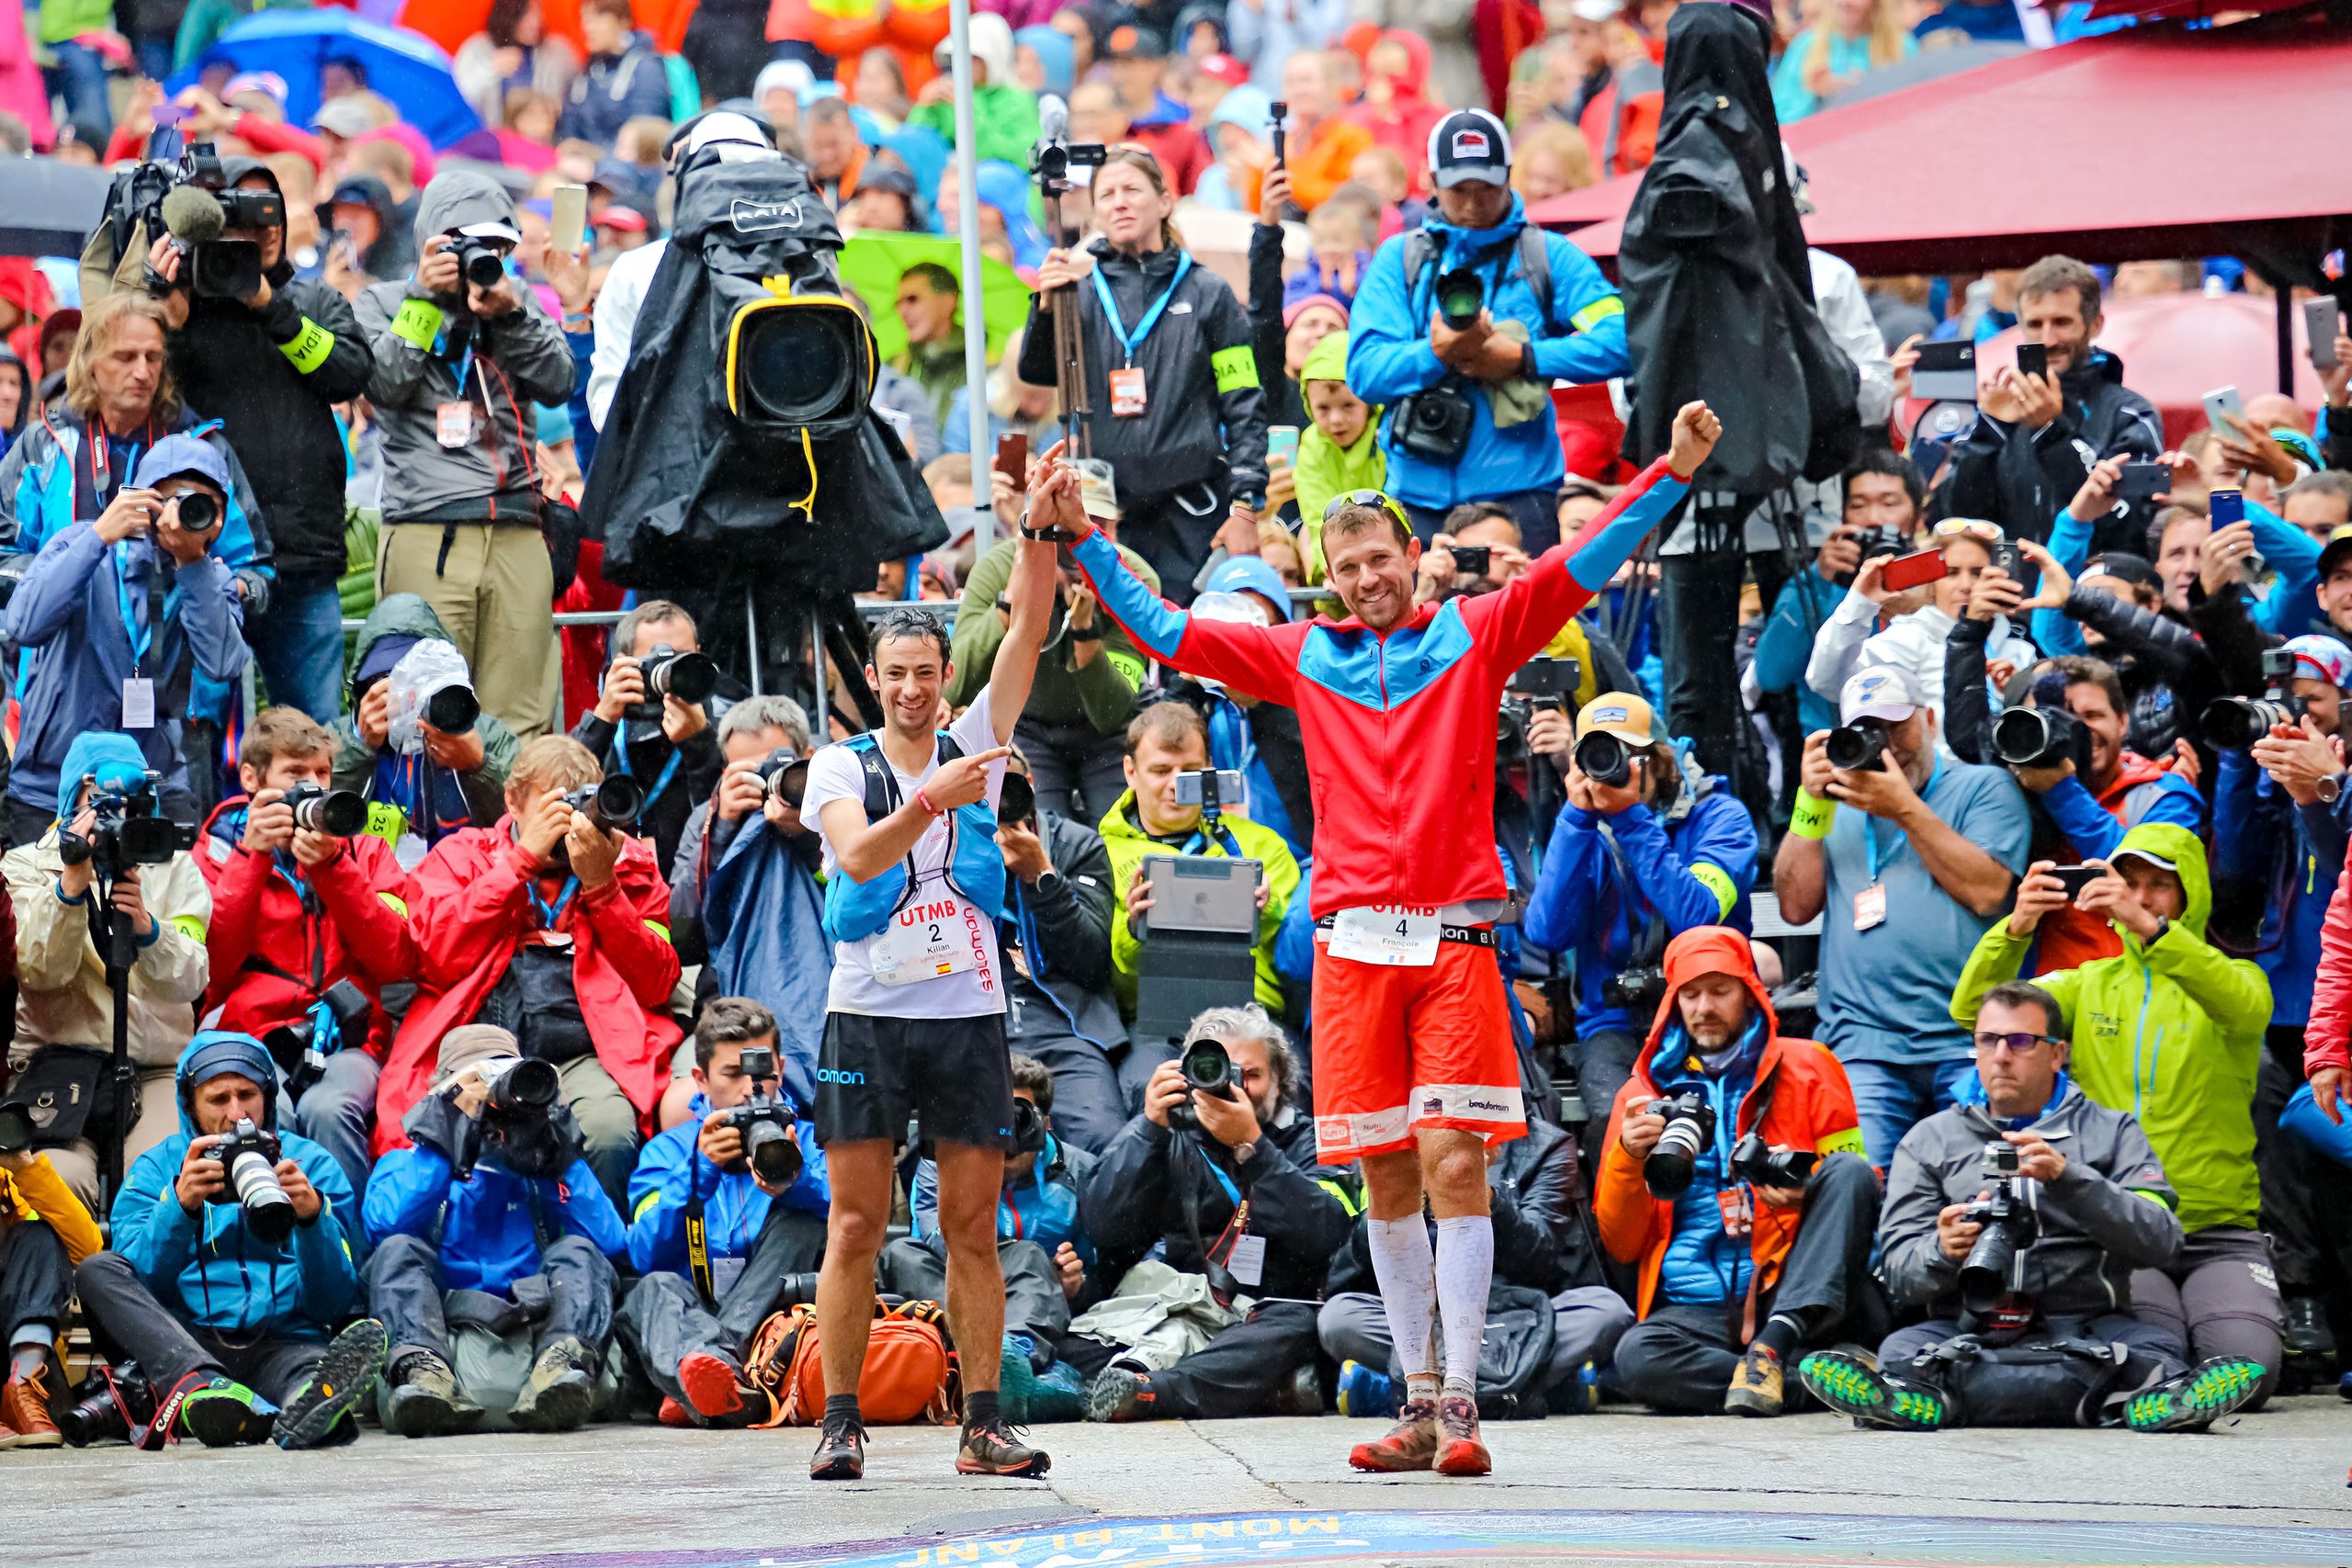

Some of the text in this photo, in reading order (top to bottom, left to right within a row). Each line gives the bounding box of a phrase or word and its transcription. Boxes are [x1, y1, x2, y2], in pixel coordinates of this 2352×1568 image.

[372, 816, 386, 832] 25
[899, 899, 956, 927] UTMB
[928, 923, 943, 942] 2
[1396, 919, 1408, 937] 4
[927, 944, 951, 954] Kilian
[1382, 938, 1419, 948] François
[1233, 1200, 1248, 1227] EOS
[154, 1390, 185, 1432] Canon
